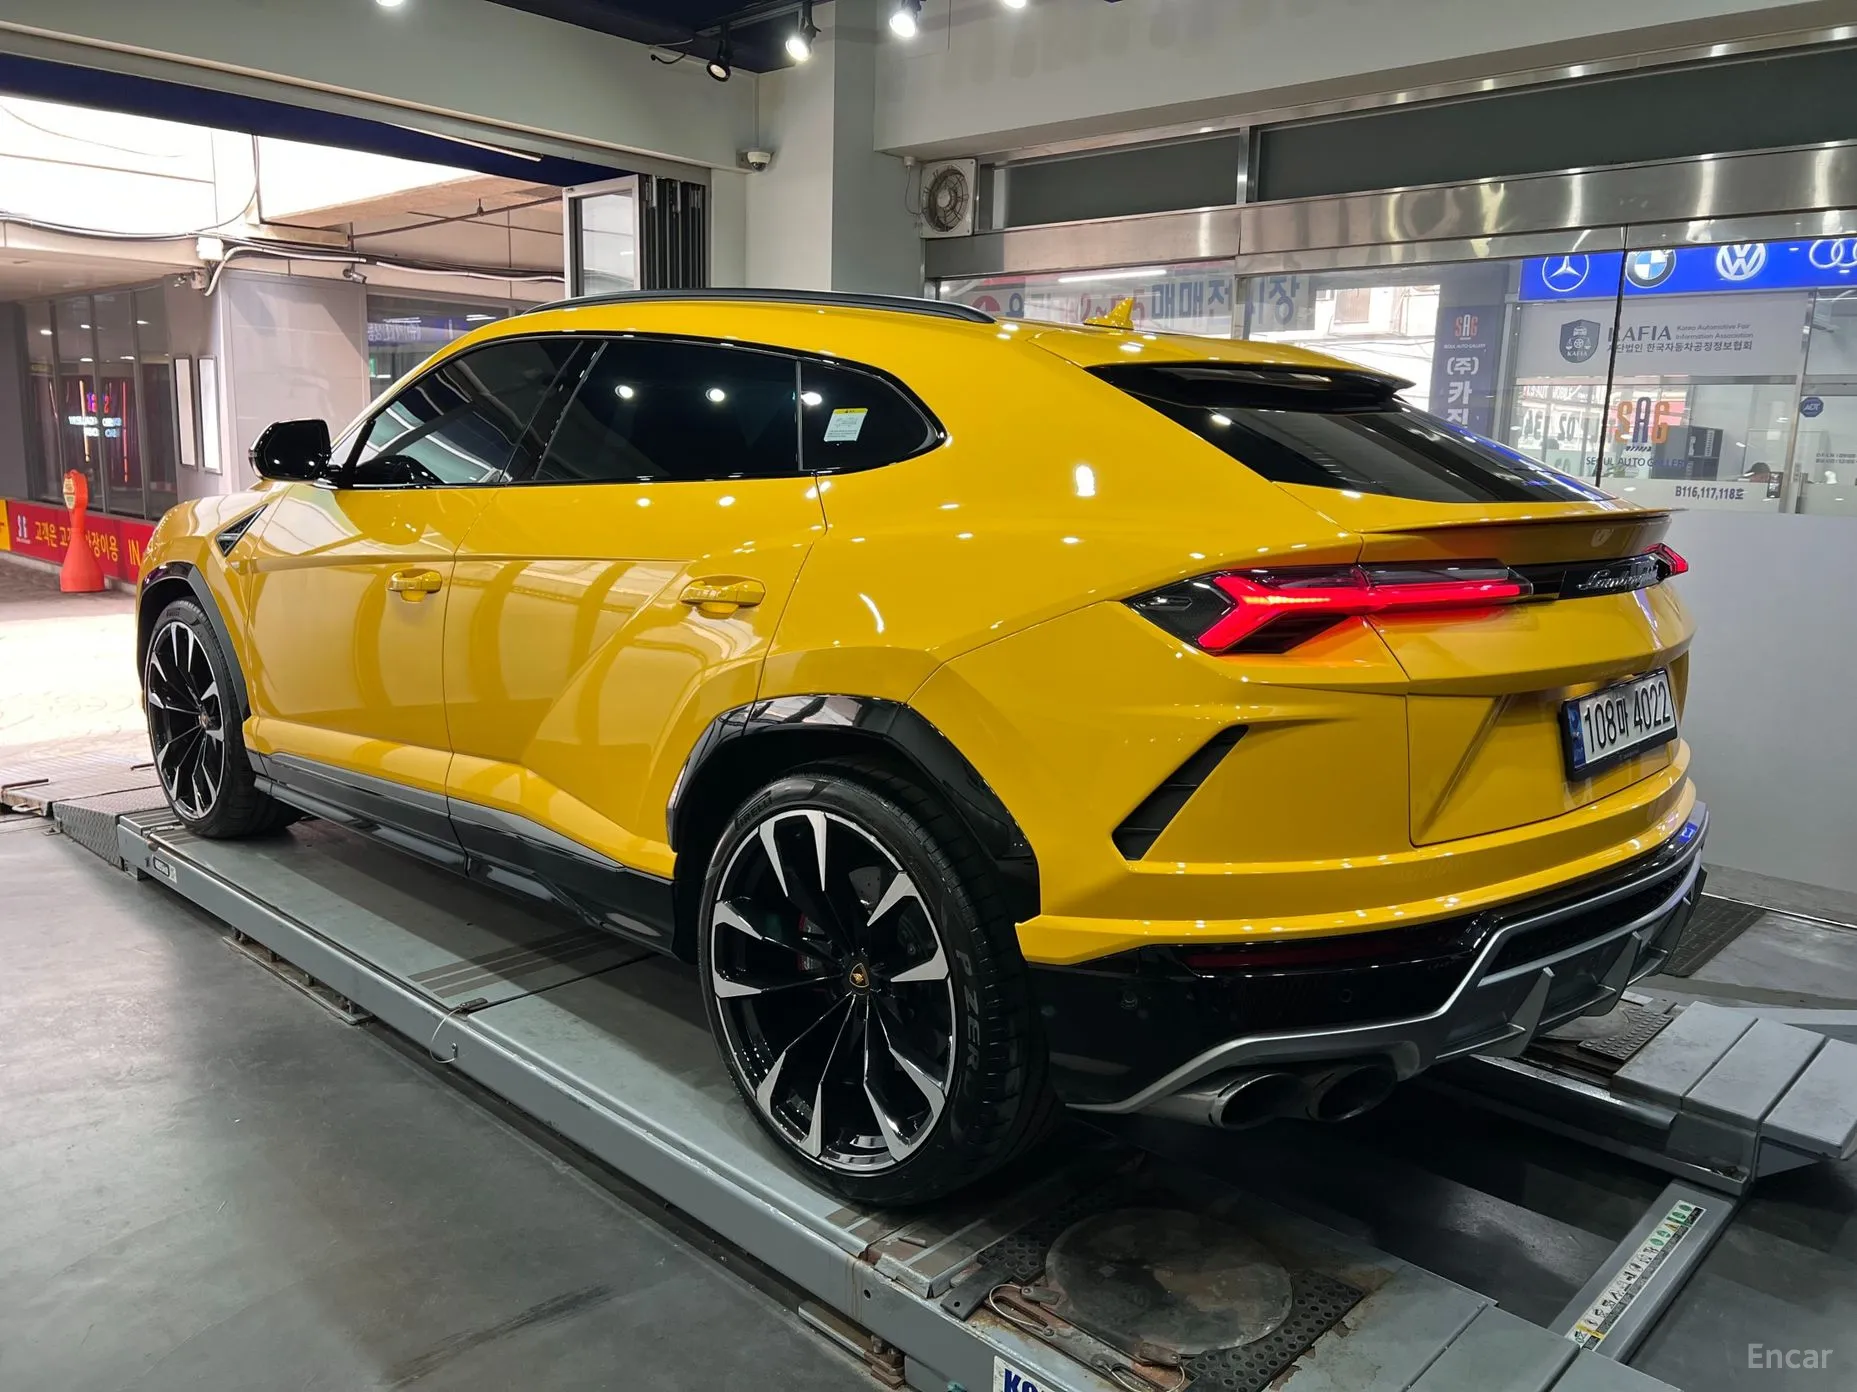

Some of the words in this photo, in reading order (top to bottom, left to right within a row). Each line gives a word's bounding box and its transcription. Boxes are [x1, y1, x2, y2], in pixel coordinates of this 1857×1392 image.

[1455, 314, 1478, 336] SAG
[1615, 396, 1670, 444] SAG
[1585, 456, 1614, 466] SEUL
[1617, 456, 1646, 467] AUTO
[1675, 485, 1745, 501] B116,117,118호
[1584, 697, 1630, 753] 108마
[1633, 681, 1671, 733] 4022
